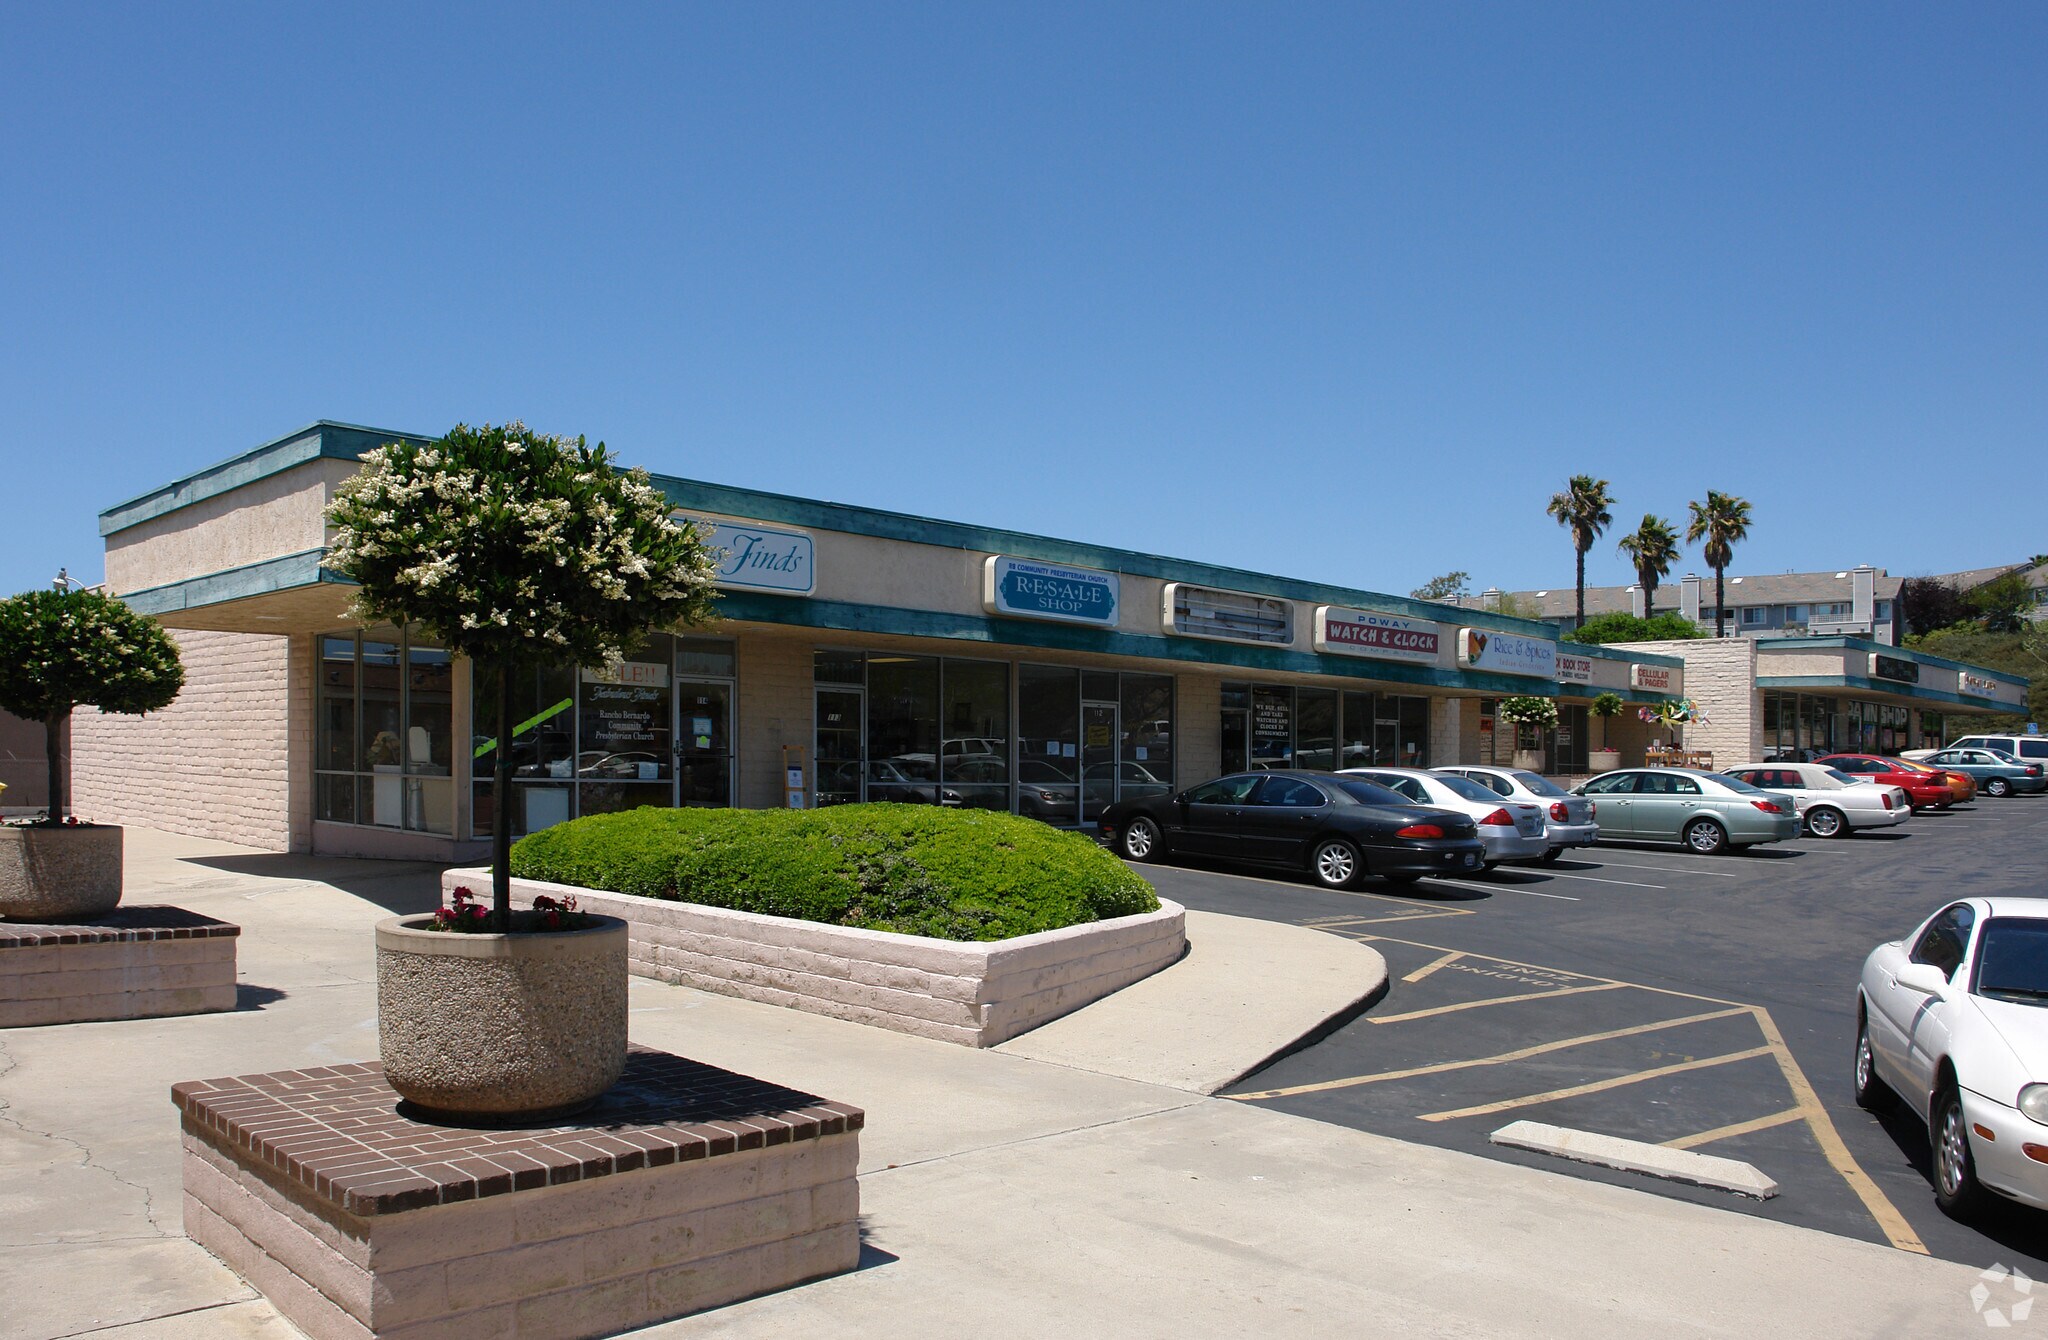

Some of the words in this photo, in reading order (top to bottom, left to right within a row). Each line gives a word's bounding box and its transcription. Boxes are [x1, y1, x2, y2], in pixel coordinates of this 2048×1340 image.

[720, 534, 803, 576] Finds
[1008, 562, 1016, 570] RB
[1017, 563, 1049, 575] COMMUNITY
[1050, 570, 1086, 580] PRESBYTERIAN
[1087, 574, 1108, 583] CHURCH
[1038, 597, 1083, 612] SHOP
[1358, 615, 1410, 628] POWAY
[1330, 624, 1378, 643] WATCH
[1381, 630, 1390, 645] &
[1393, 632, 1434, 649] CLOCK
[1348, 645, 1419, 657] COMPANY
[1494, 637, 1514, 655] Rice
[1525, 641, 1551, 663] Spices
[1563, 658, 1576, 670] BOOK
[1577, 660, 1591, 672] STORE
[620, 664, 656, 683] LE!!
[1638, 669, 1669, 679] CELLULAR
[1645, 679, 1668, 688] PAGERS
[600, 710, 622, 719] Rancho
[623, 710, 651, 720] Bernardo
[1880, 704, 1908, 726] SHOP
[608, 720, 642, 731] Community
[595, 731, 632, 741] Presbyterian
[633, 731, 654, 741] Church
[1445, 963, 1573, 990] LOADING
[1492, 963, 1578, 982] ZONE
